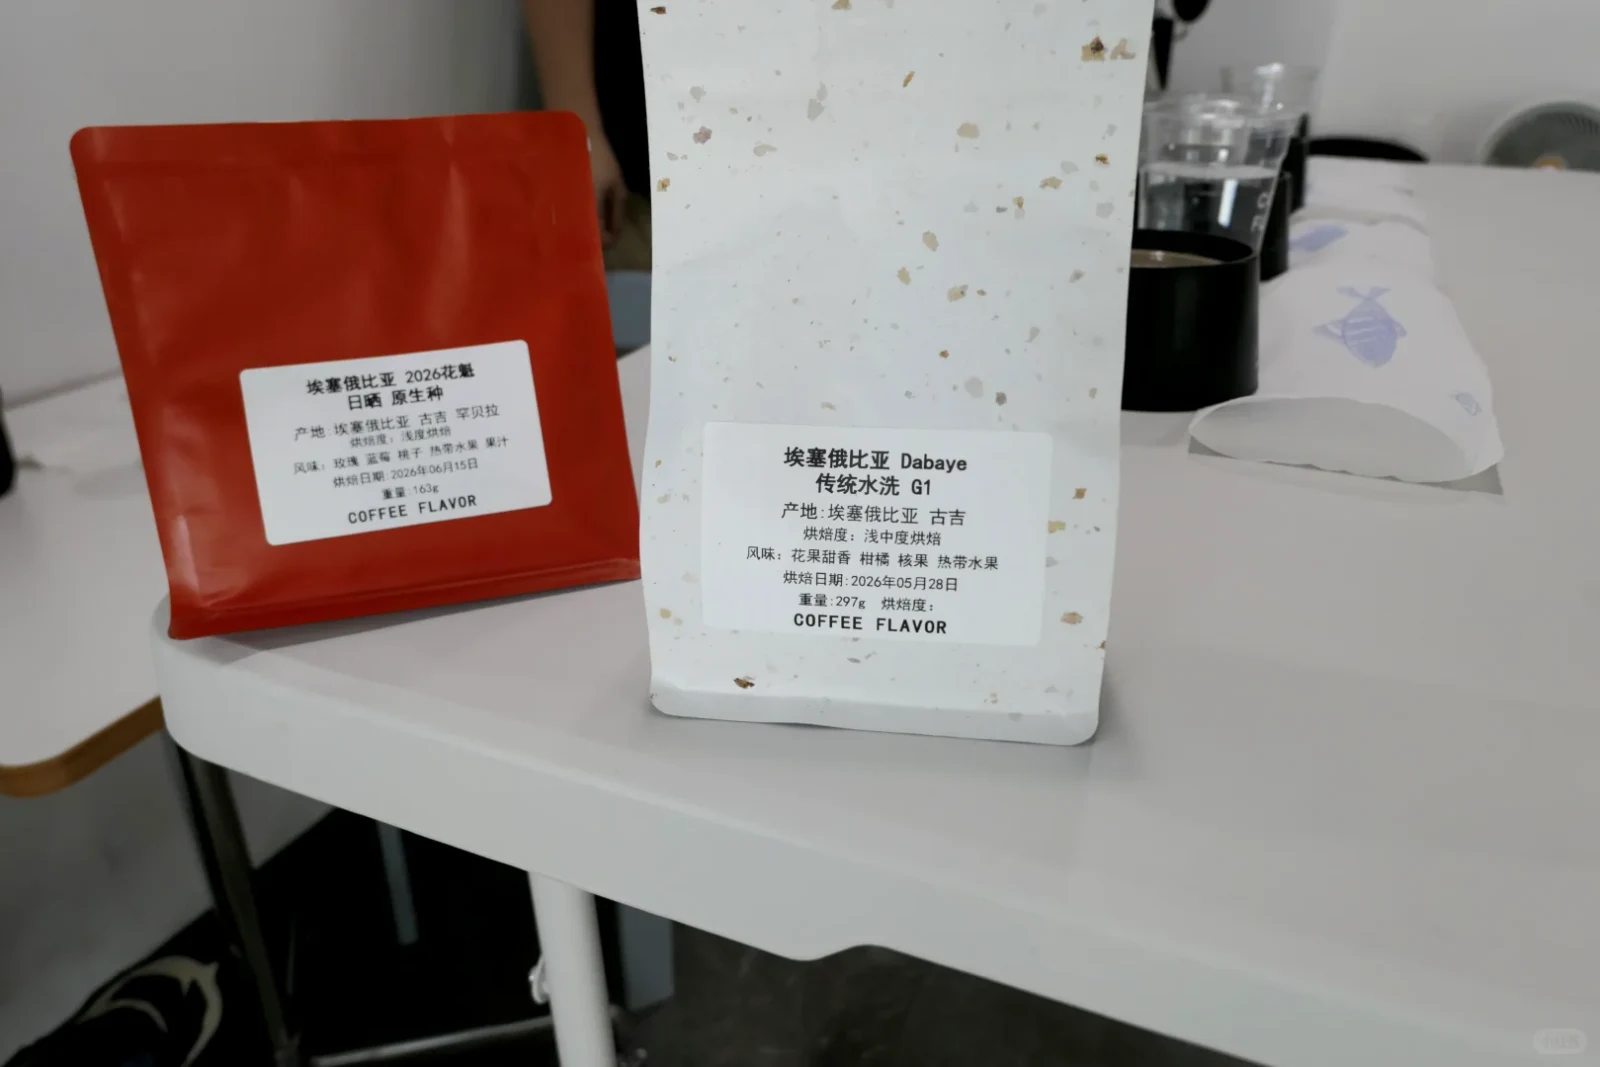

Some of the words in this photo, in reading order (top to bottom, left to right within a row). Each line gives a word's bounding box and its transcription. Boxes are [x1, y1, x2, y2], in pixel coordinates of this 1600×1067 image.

[307, 372, 396, 395] 埃塞俄比亚
[405, 362, 474, 384] 2026花魁
[348, 394, 382, 410] 日晒
[392, 386, 443, 406] 原生种
[419, 411, 447, 426] 古吉
[456, 404, 500, 420] 罕贝拉
[367, 452, 390, 465] 蓝莓
[398, 448, 422, 461] 桃子
[430, 439, 478, 456] 热带水果
[486, 436, 509, 448] 果汁
[784, 447, 889, 470] 埃塞俄比亚
[900, 453, 967, 473] Dabaye
[816, 474, 899, 496] 传统水洗
[911, 479, 931, 495] G1
[348, 505, 408, 524] COFFEE
[419, 495, 477, 514] FLAVOR
[930, 509, 966, 526] 古吉
[860, 552, 889, 566] 柑橘
[898, 553, 928, 567] 核果
[937, 555, 998, 570] 热带水果
[794, 614, 863, 630] COFFEE
[876, 618, 947, 634] FLAVOR
